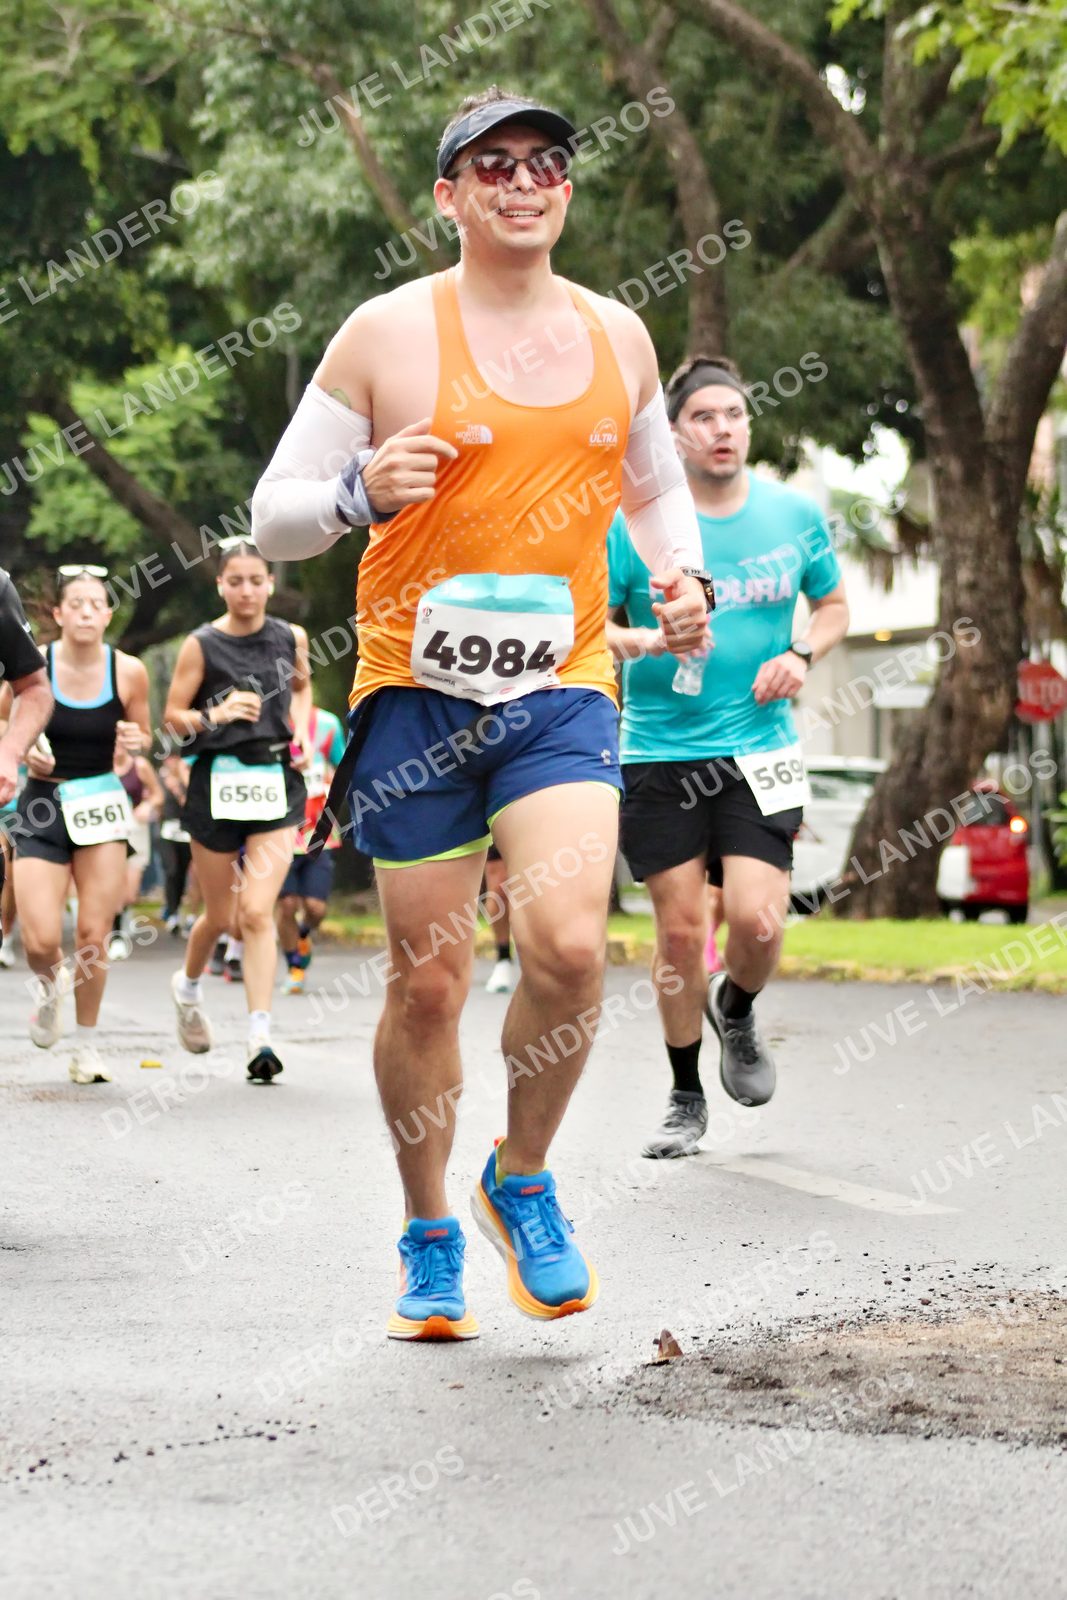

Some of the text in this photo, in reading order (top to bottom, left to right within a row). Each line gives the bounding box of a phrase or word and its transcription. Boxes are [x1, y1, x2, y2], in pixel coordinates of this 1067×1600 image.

[589, 432, 618, 443] ULTRA
[423, 630, 556, 677] 4984
[753, 758, 804, 790] 569
[219, 786, 278, 802] 6566
[73, 804, 125, 828] 6561
